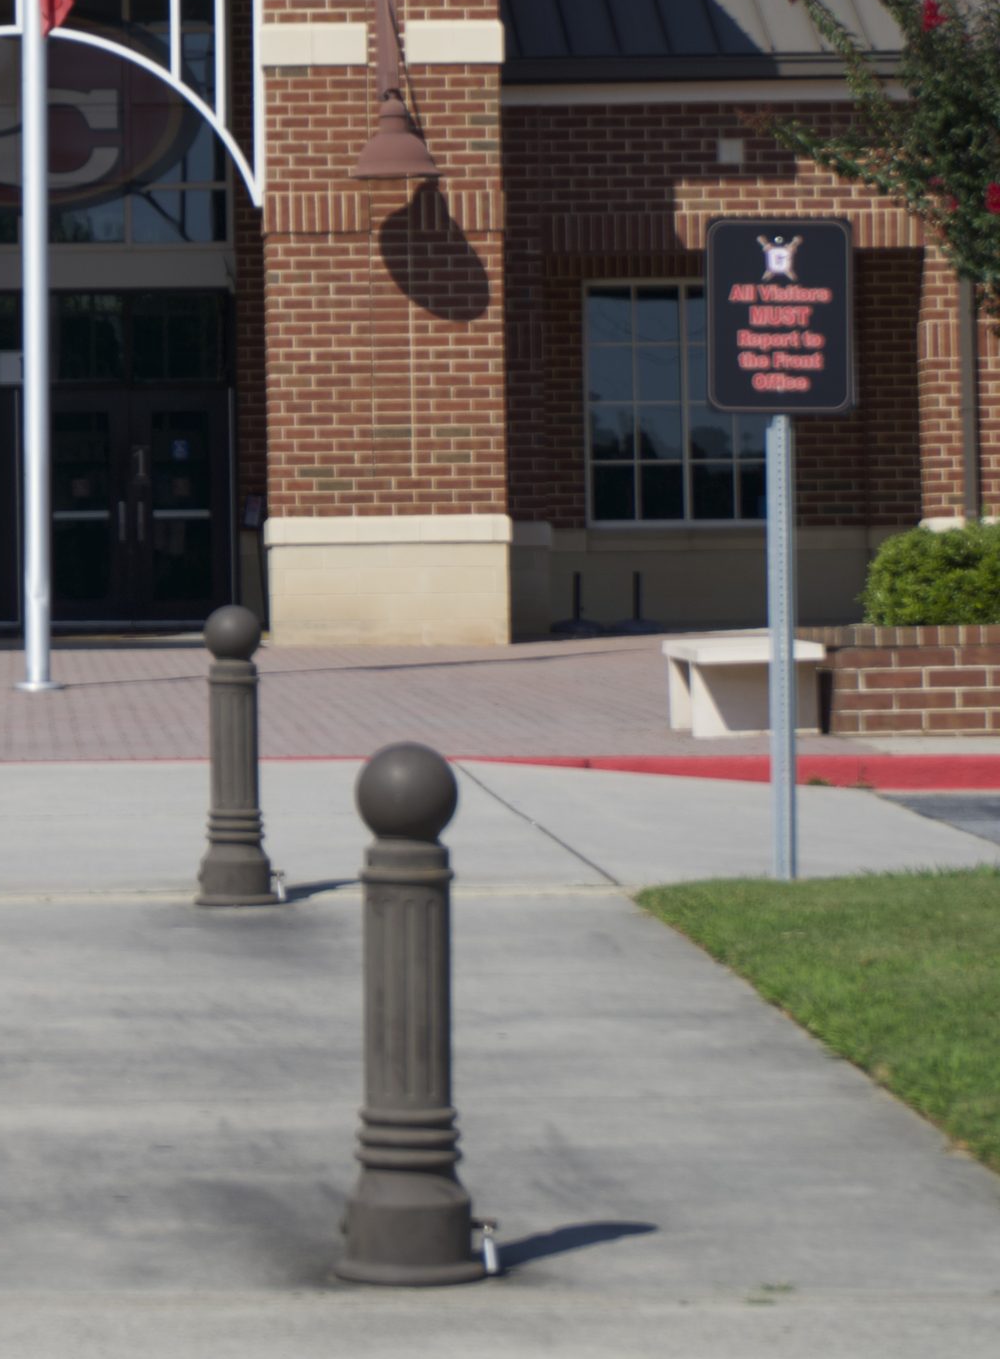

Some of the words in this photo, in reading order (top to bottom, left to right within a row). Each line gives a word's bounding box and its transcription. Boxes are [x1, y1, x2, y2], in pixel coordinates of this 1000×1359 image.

[728, 283, 757, 302] All
[758, 283, 832, 304] Visitors
[749, 305, 813, 327] MUST
[737, 329, 801, 351] Report
[801, 331, 825, 349] to
[738, 351, 770, 370] the
[771, 351, 824, 371] Front
[752, 372, 811, 393] Office
